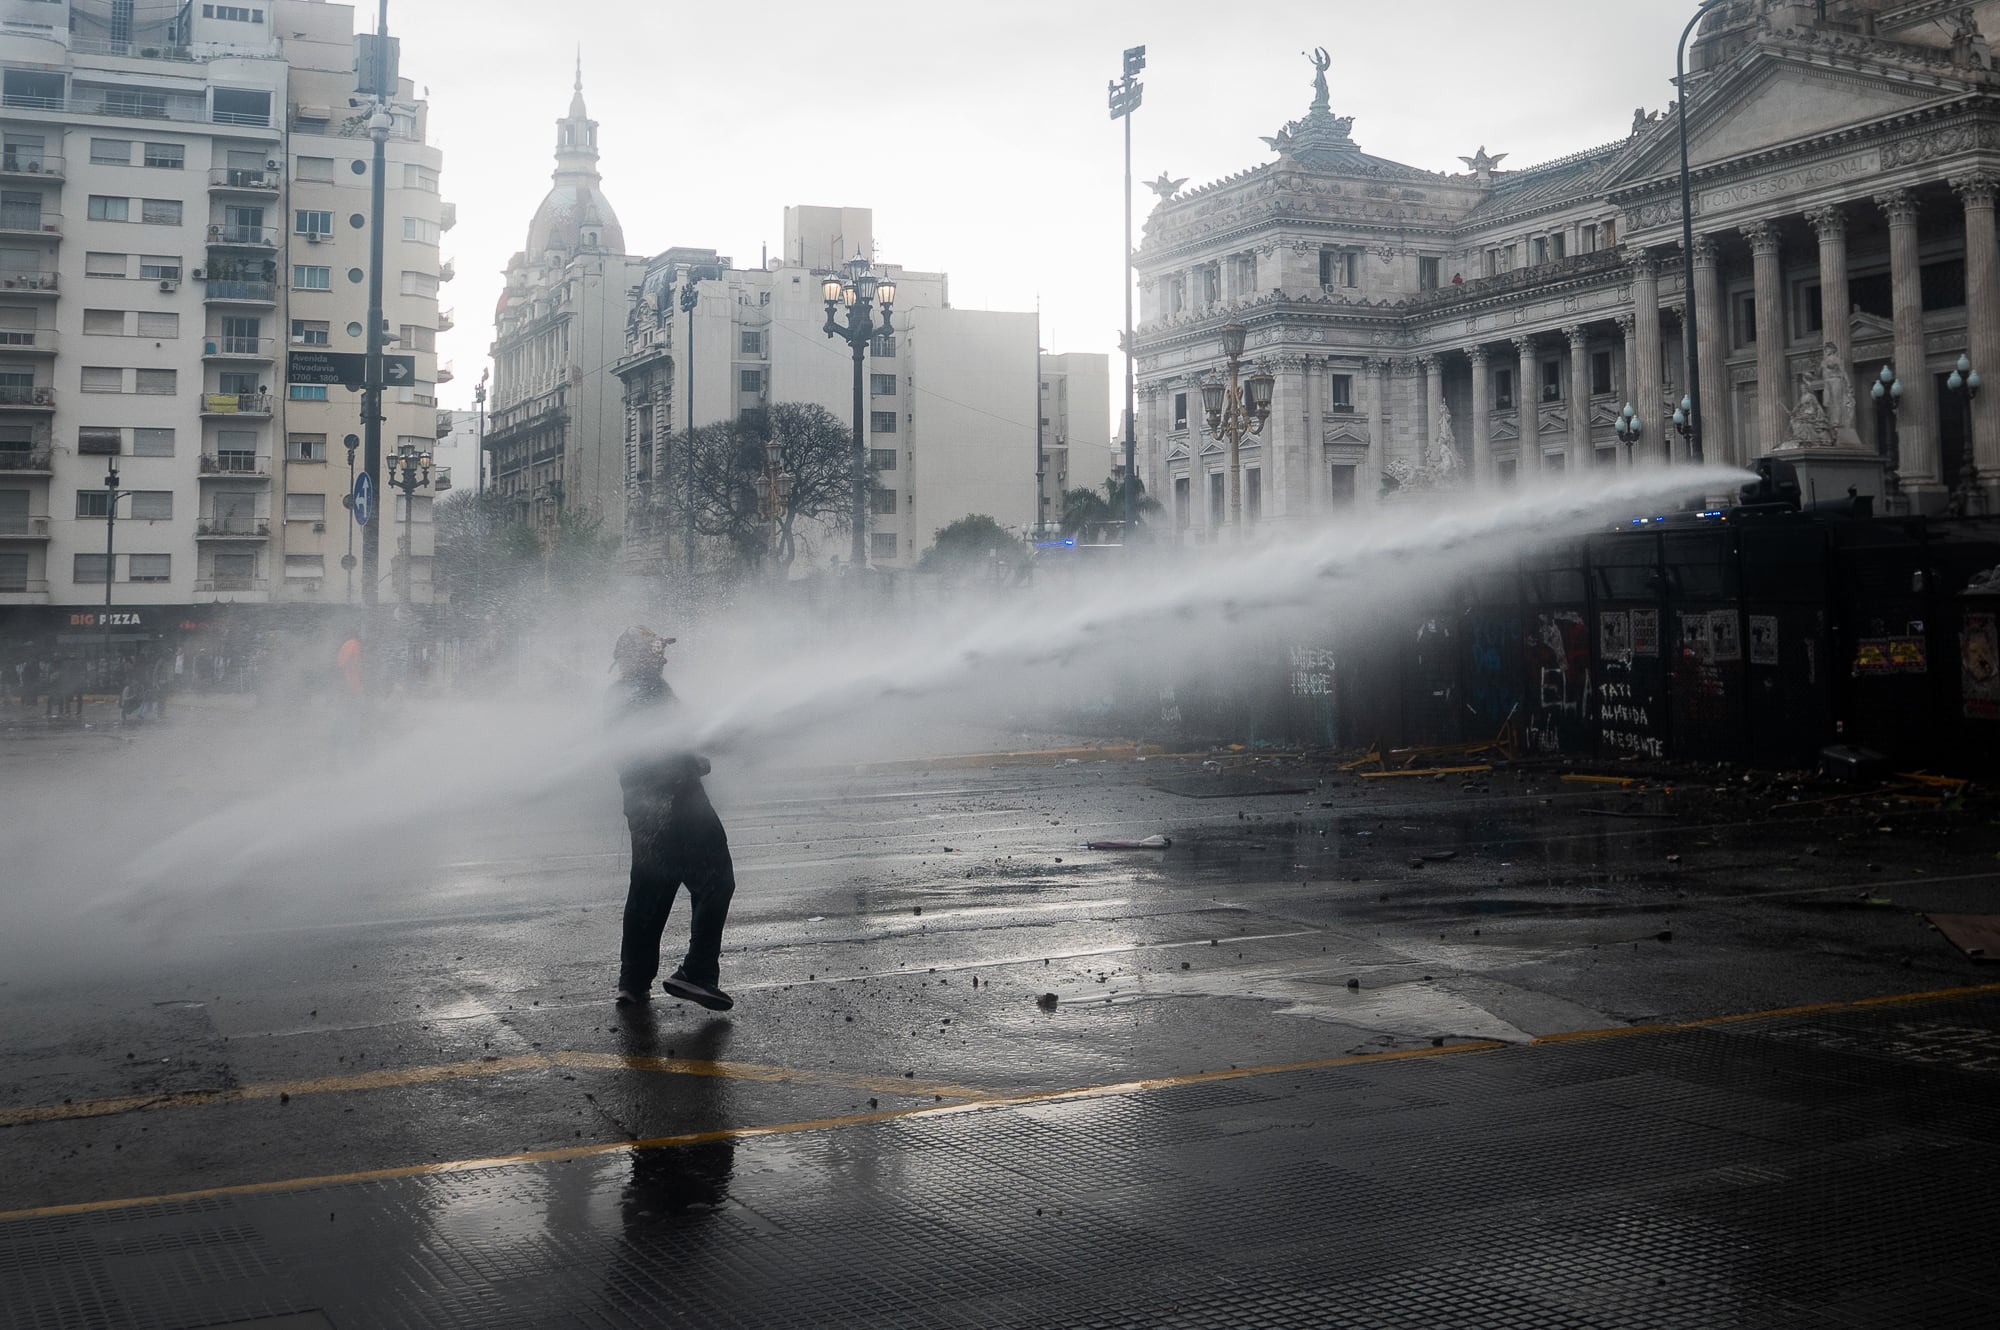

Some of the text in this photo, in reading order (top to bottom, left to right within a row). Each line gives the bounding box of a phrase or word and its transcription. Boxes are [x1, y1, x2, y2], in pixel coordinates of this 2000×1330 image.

[1712, 157, 1868, 207] CONGRESO NACIONAL
[293, 353, 328, 363] Avenida
[292, 363, 335, 373] Rivadavia
[292, 373, 312, 381] 1700
[319, 374, 339, 383] 1800
[70, 613, 142, 625] BIG PIZZA
[1599, 682, 1632, 698] TATI
